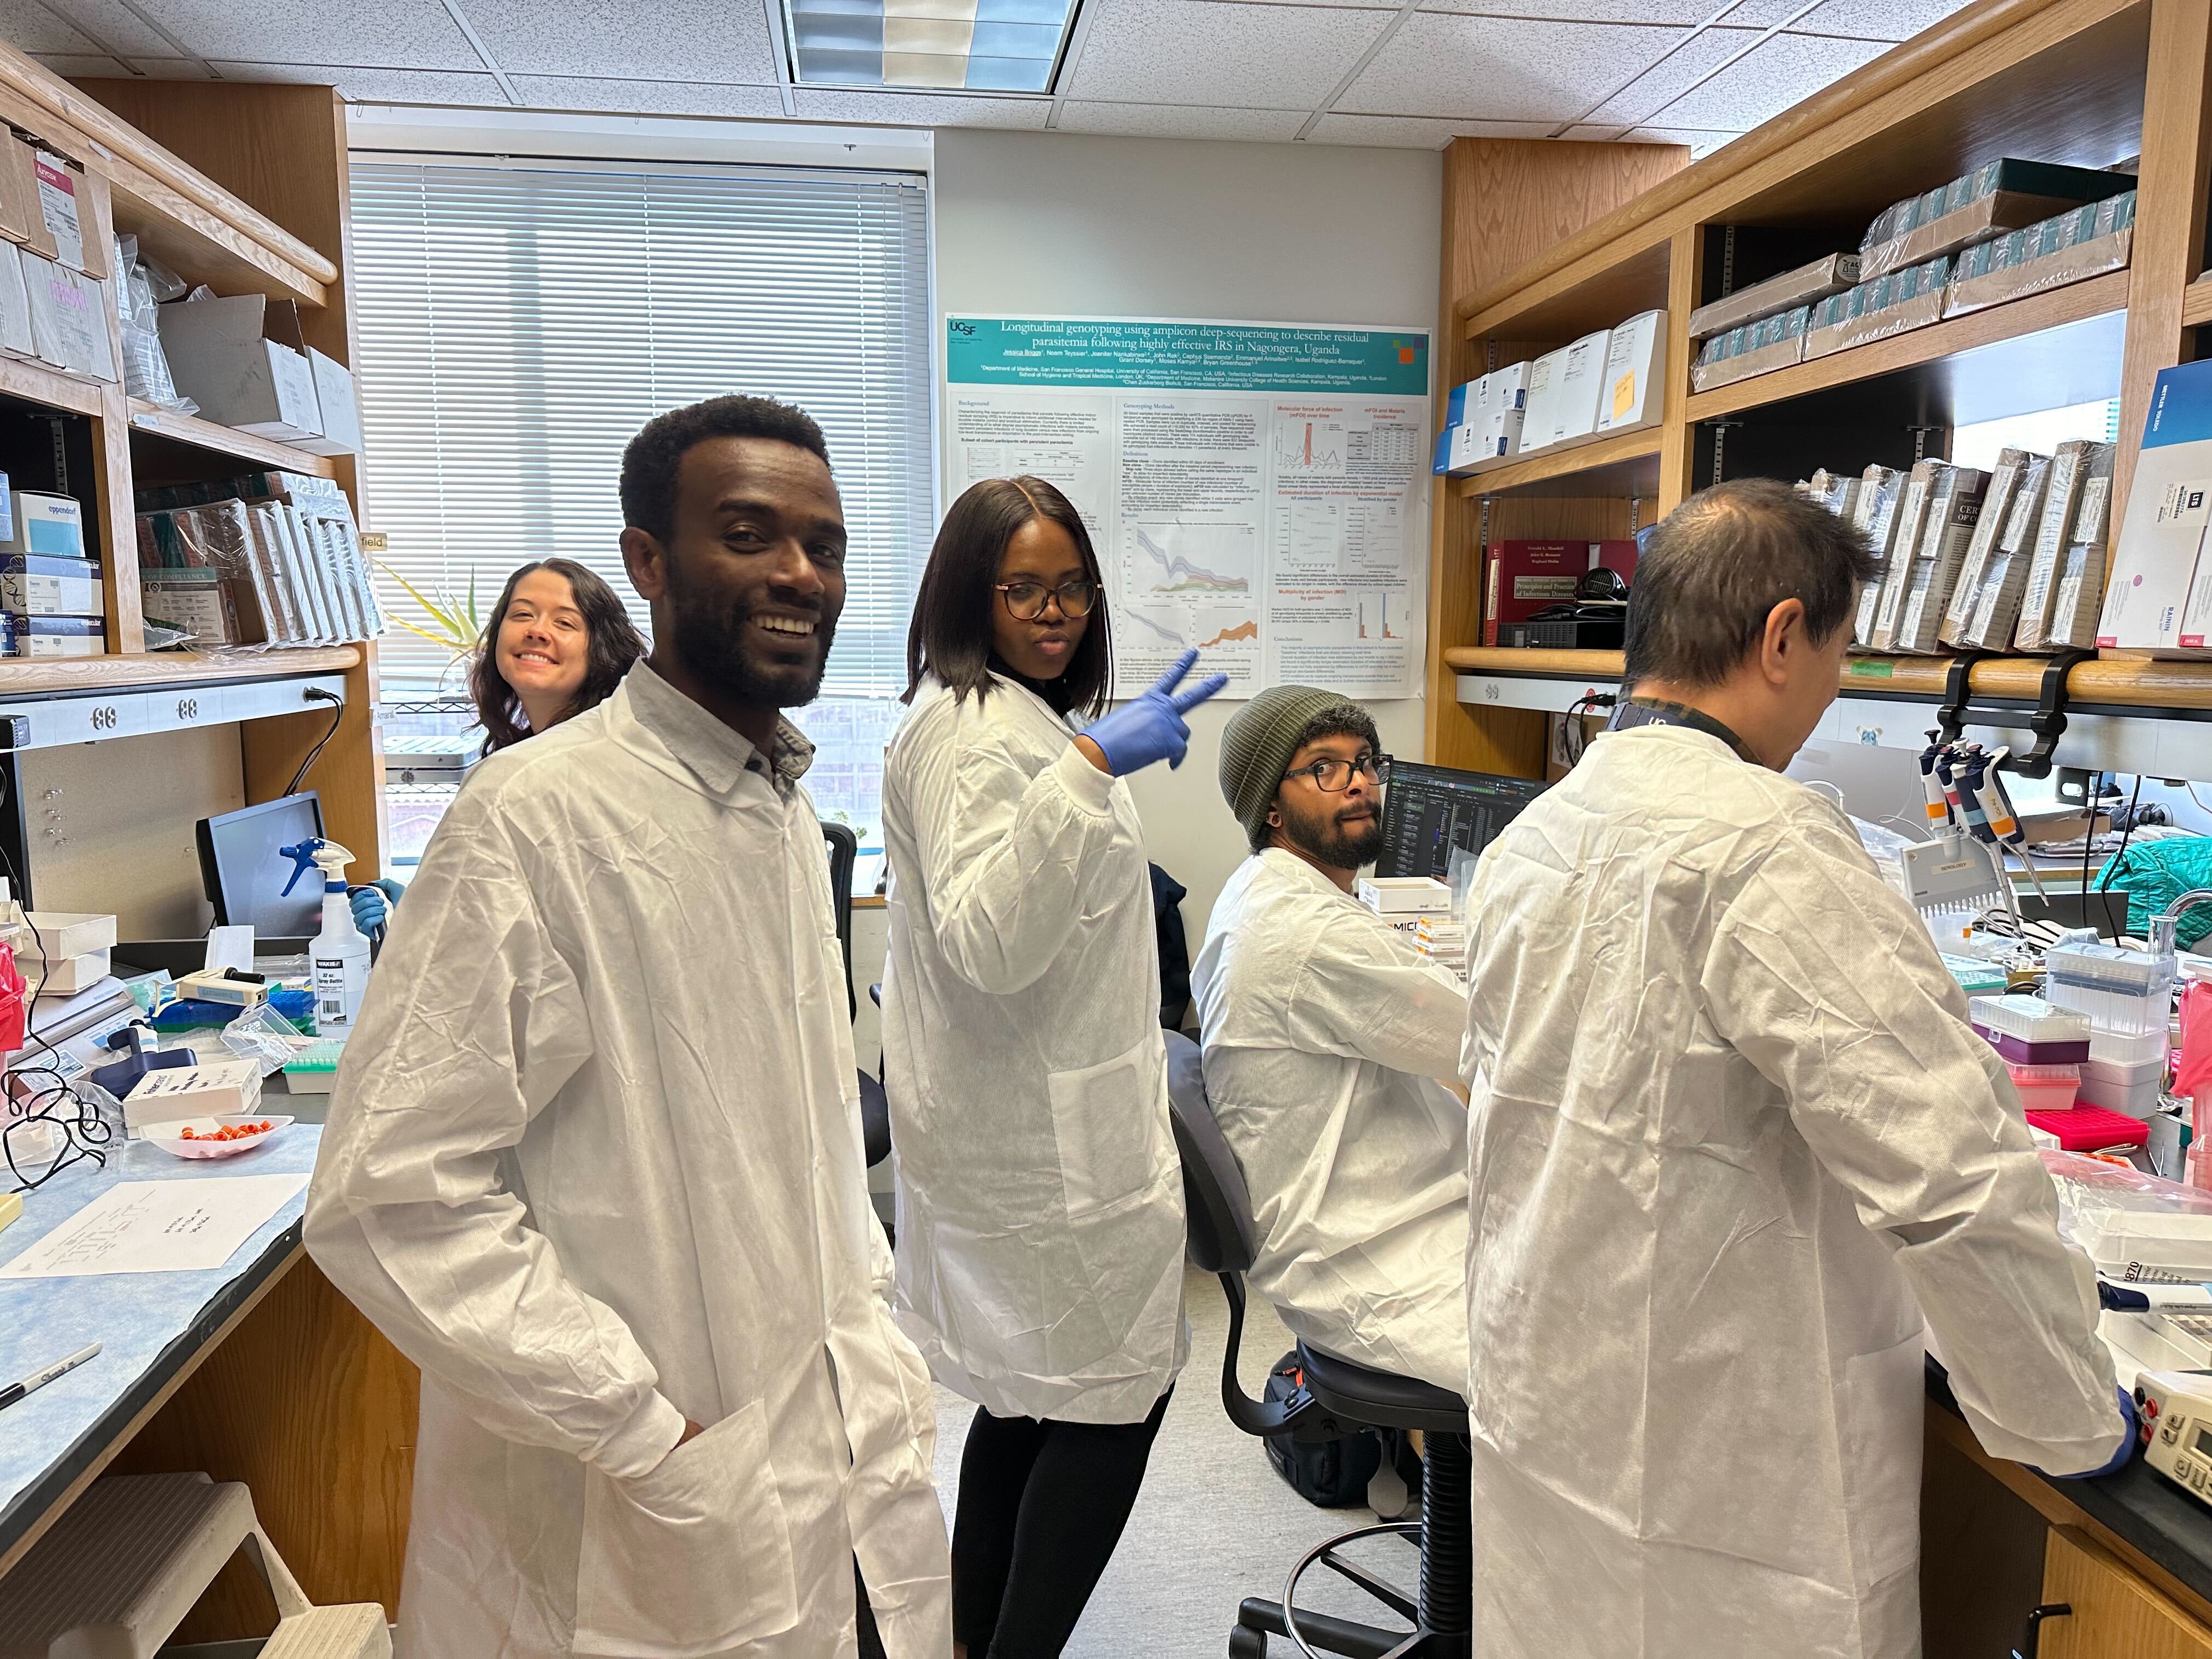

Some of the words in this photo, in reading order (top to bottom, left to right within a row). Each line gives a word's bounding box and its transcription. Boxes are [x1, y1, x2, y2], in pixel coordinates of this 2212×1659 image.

[950, 321, 976, 336] UCSF
[1001, 321, 1063, 335] Longitudinal
[1066, 323, 1121, 336] genotyping
[1124, 324, 1150, 337] using
[1153, 325, 1197, 338] amplicon
[1200, 326, 1278, 341] deep-sequencing
[1281, 329, 1291, 339] to
[1293, 330, 1331, 341] describe
[1334, 332, 1369, 342] residual
[1032, 336, 1087, 349] parasitemia
[1091, 337, 1137, 351] following
[1139, 338, 1169, 351] highly
[1171, 339, 1211, 349] effective
[1215, 341, 1232, 351] IRS
[1235, 341, 1244, 351] in
[1247, 342, 1301, 356] Nagongera,
[1305, 344, 1339, 357] Uganda
[2158, 385, 2168, 409] METTLER
[2152, 408, 2161, 432] TOLEDO
[2191, 494, 2200, 506] LTS
[48, 505, 76, 515] eppendorf
[360, 537, 383, 547] field
[2164, 607, 2174, 631] RAININ
[1940, 862, 1966, 871] SEROLOGY
[1393, 922, 1417, 932] MIC
